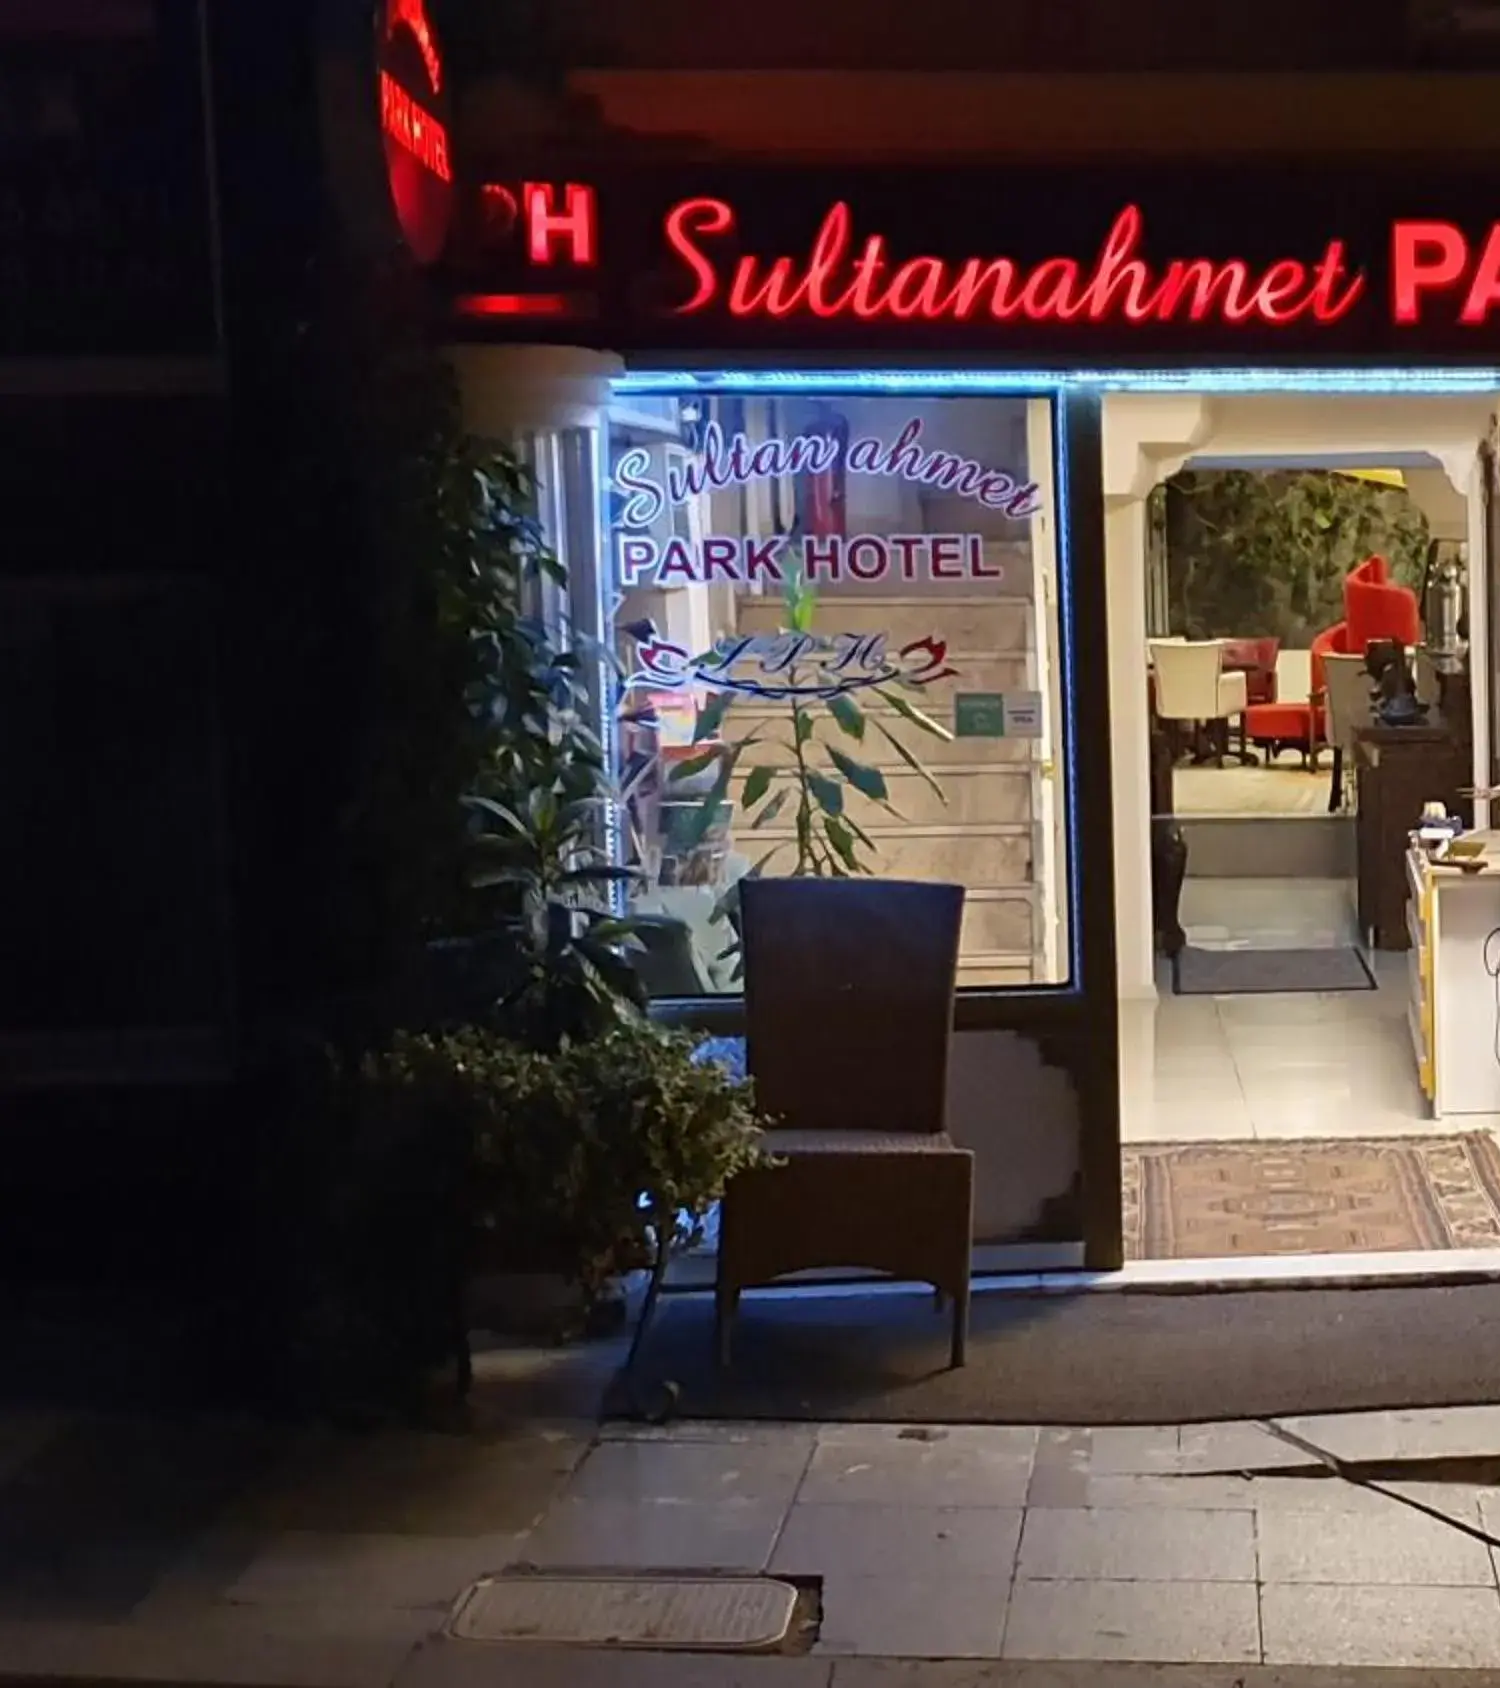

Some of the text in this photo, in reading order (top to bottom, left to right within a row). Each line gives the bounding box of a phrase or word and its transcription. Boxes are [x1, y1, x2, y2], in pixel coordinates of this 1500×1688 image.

[664, 198, 1366, 327] Sultanahmet
[616, 417, 1046, 529] Sultan ahmet
[620, 533, 1003, 586] PARK HOTEL
